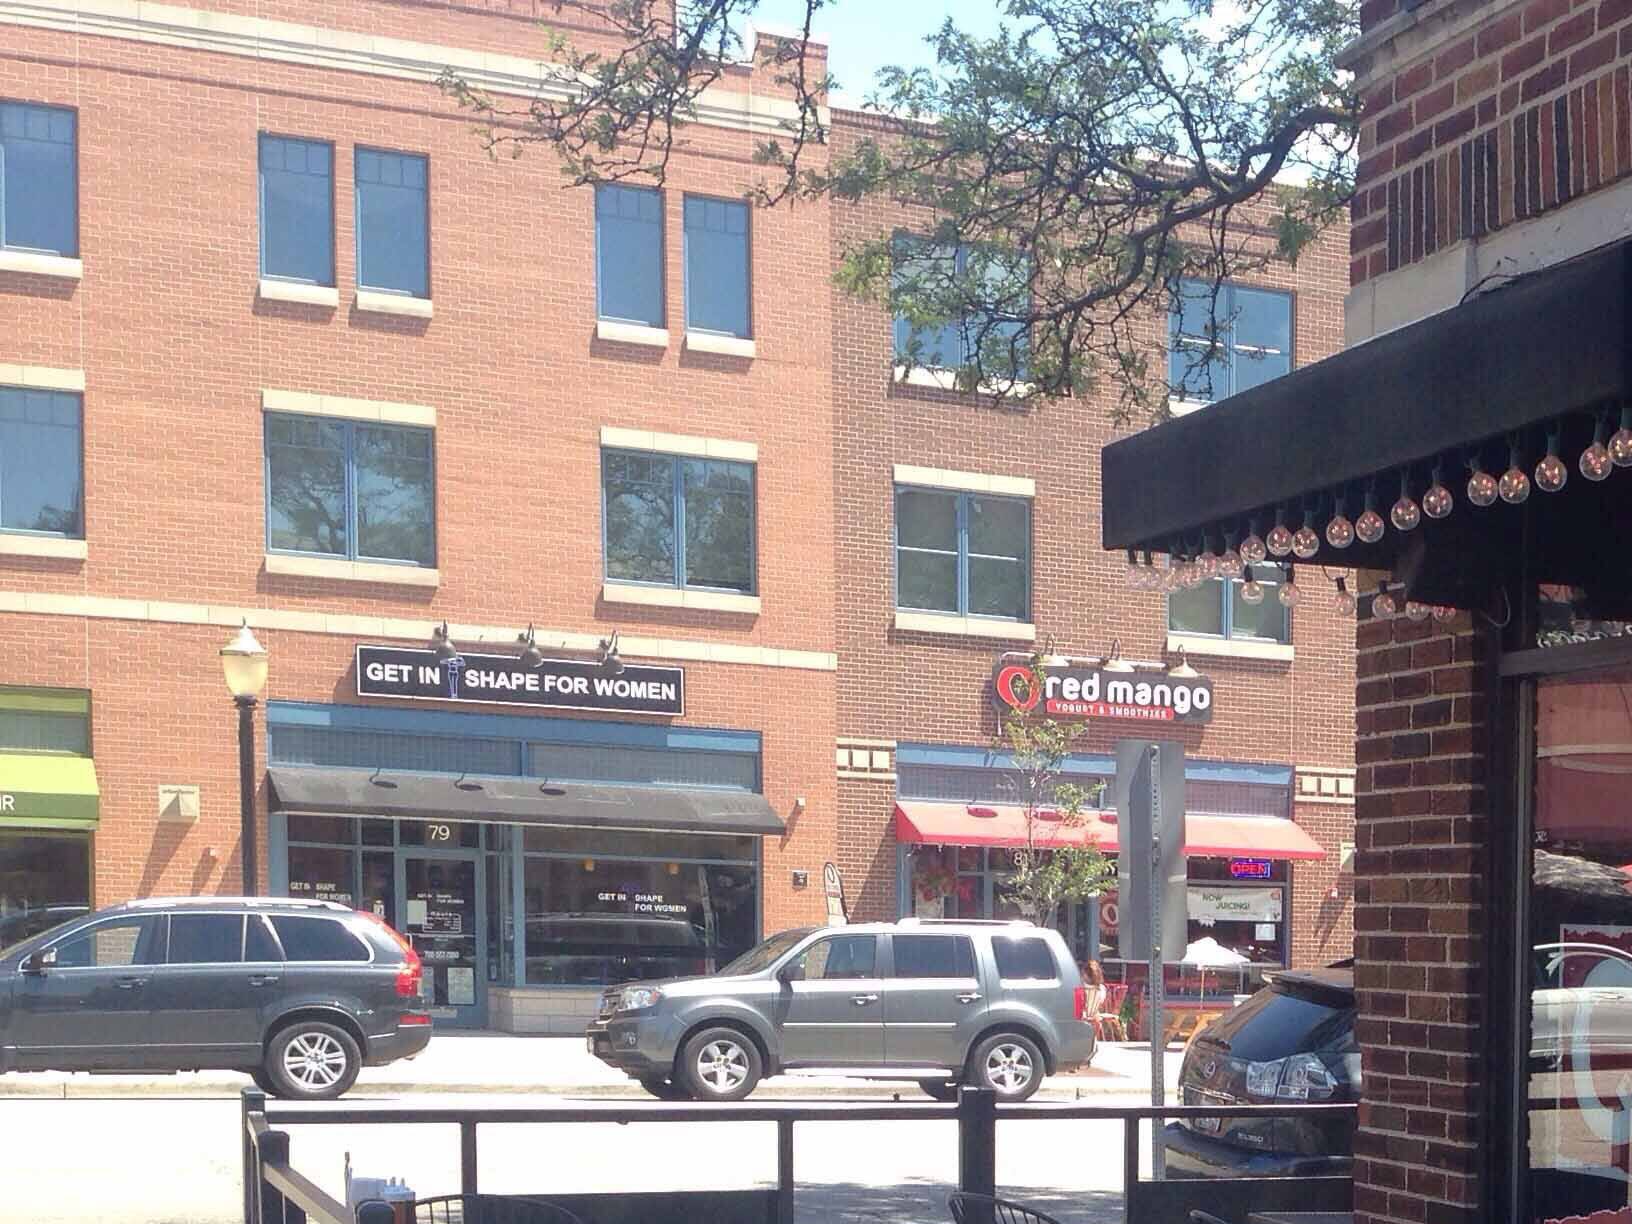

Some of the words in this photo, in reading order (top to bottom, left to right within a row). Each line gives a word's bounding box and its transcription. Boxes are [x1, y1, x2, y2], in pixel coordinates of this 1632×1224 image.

[366, 662, 413, 684] GET
[419, 665, 441, 685] IN
[464, 669, 540, 692] SHAPE
[544, 675, 589, 695] FOR
[593, 678, 676, 701] WOMEN
[1045, 672, 1100, 701] red
[1107, 680, 1210, 714] mango
[1055, 703, 1094, 715] YOGURT
[1109, 706, 1167, 720] SMOOTHIES
[428, 824, 450, 841] 79
[1231, 863, 1265, 874] OPEN
[598, 892, 616, 901] GET
[617, 893, 626, 902] IN
[635, 894, 663, 903] SHAPE
[1202, 893, 1223, 902] NOW
[635, 903, 652, 912] FOR
[654, 904, 687, 913] WOMEN
